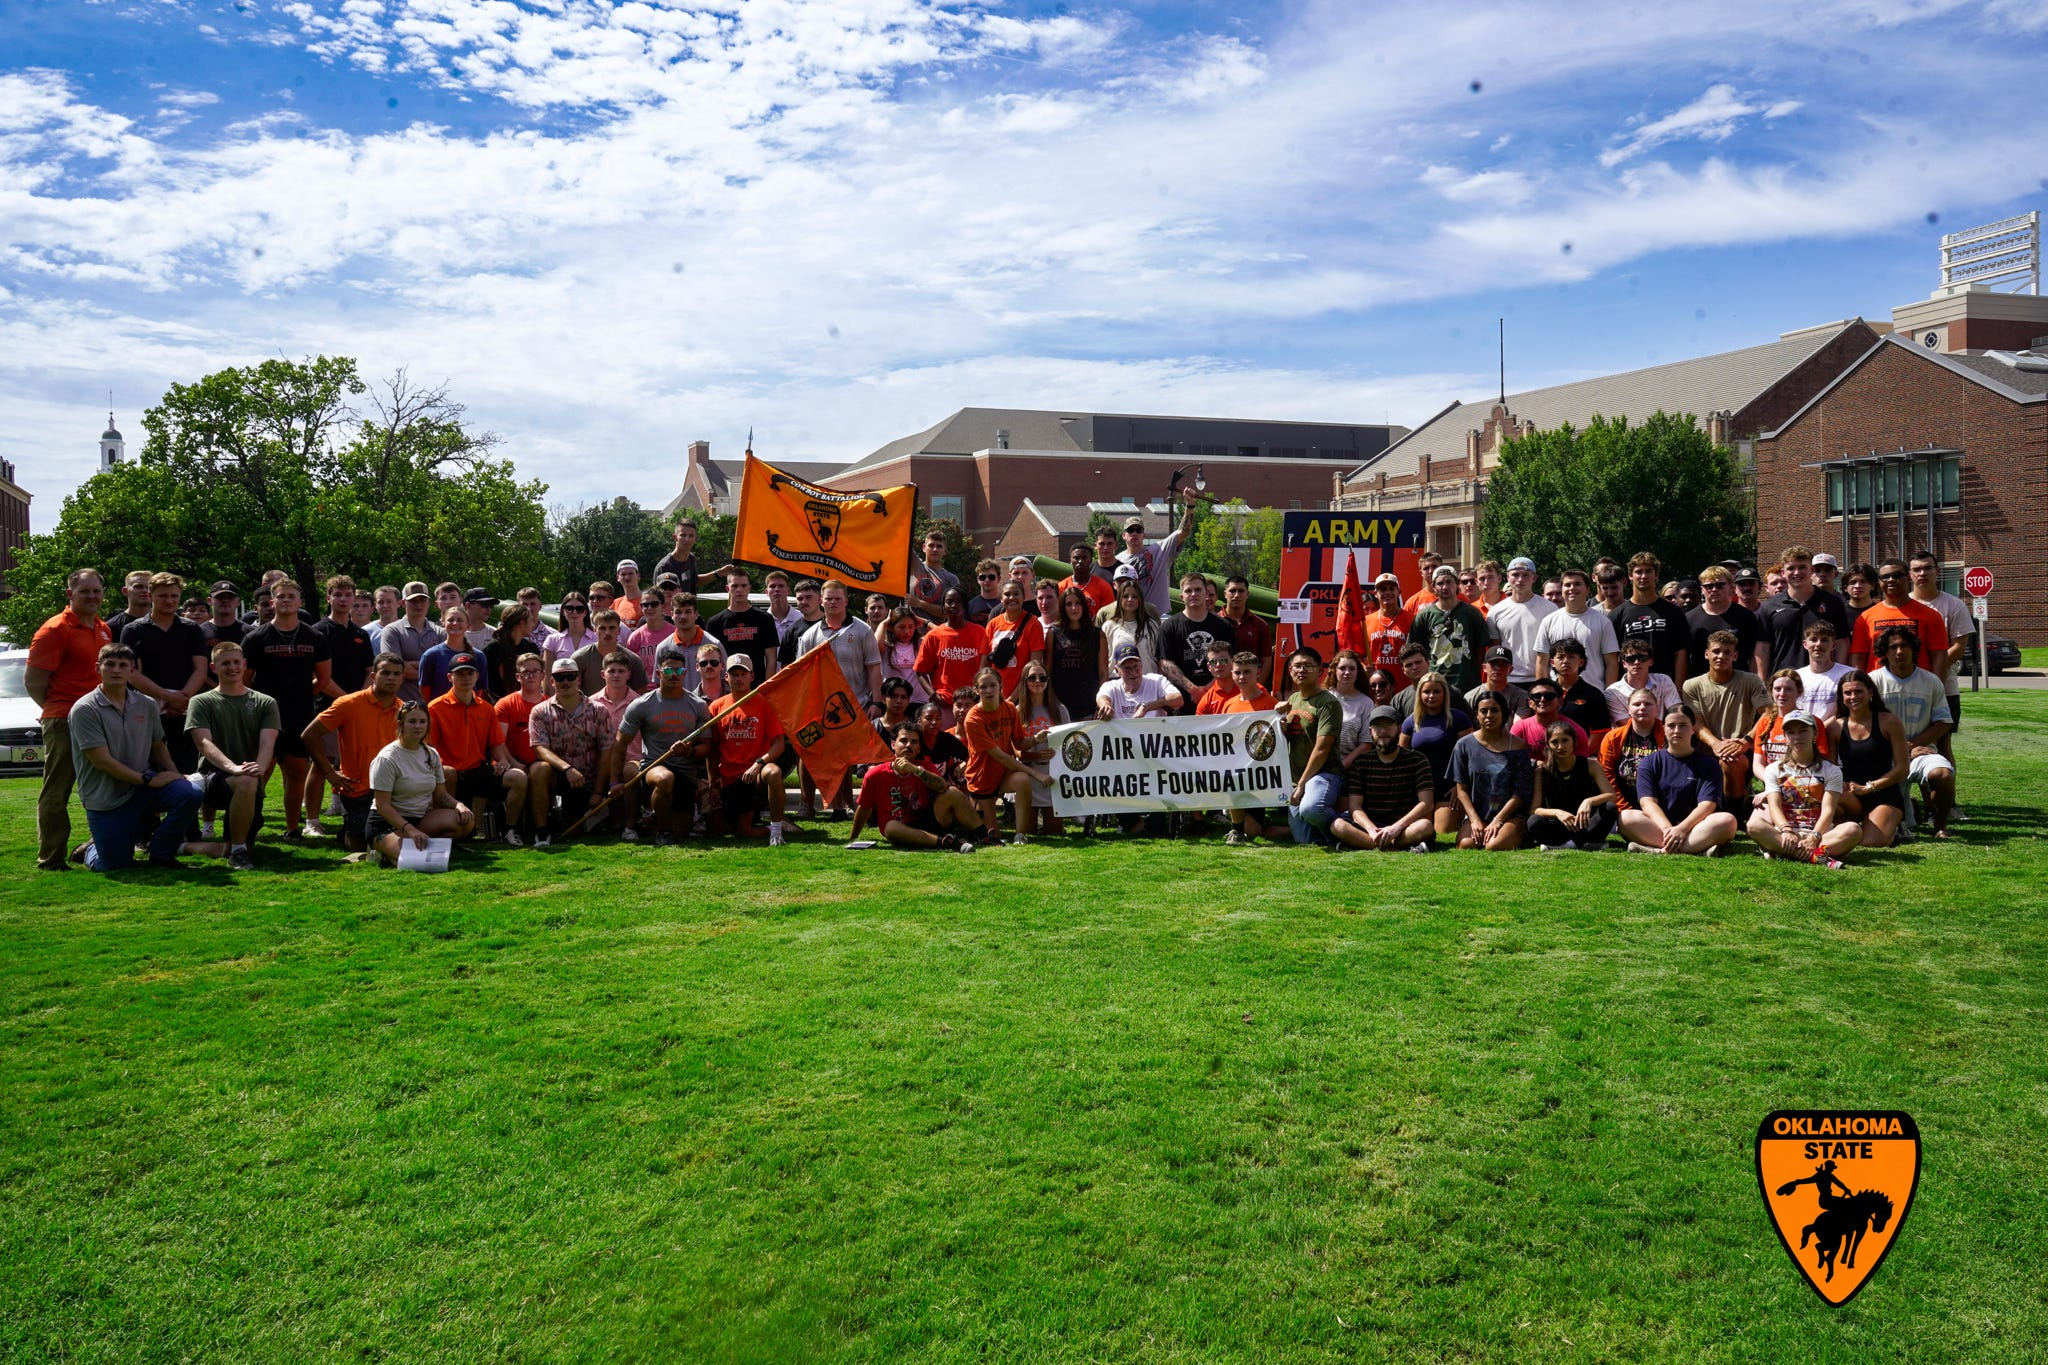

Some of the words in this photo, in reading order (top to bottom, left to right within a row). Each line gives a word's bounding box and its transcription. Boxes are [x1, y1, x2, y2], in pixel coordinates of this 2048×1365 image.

[790, 480, 822, 499] COWBOY
[821, 494, 866, 502] BATTALION
[1303, 519, 1404, 544] ARMY
[772, 546, 799, 561] RESERVE
[798, 553, 825, 564] OFFICER
[824, 558, 855, 576] TRAINING
[855, 571, 878, 580] CORPS
[1967, 576, 1991, 588] STOP
[1370, 629, 1406, 641] OKLAHOMA
[940, 646, 979, 658] OKLAHOMA
[1377, 656, 1399, 665] STATE
[1101, 735, 1135, 761] AIR
[1140, 733, 1236, 759] WARRIOR
[1059, 773, 1151, 799] COURAGE
[1157, 765, 1283, 795] FOUNDATION
